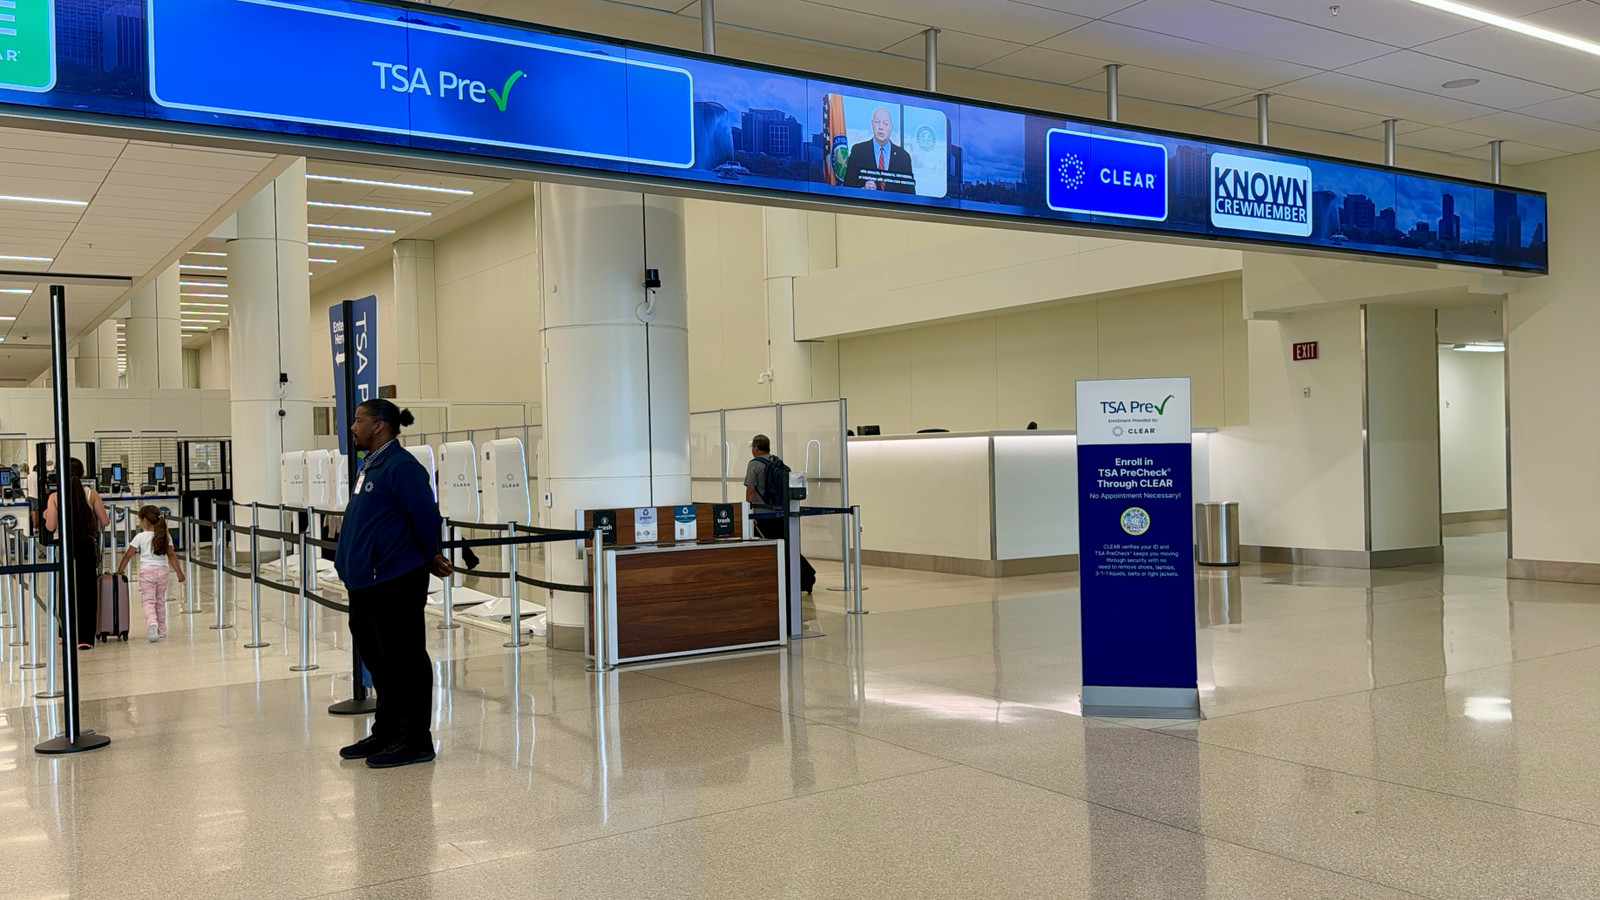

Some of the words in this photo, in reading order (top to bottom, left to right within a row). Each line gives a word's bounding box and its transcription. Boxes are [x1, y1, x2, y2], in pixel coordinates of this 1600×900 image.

[372, 60, 432, 96] TSA
[439, 70, 486, 104] Pre
[1100, 168, 1155, 190] CLEAR
[1214, 166, 1307, 207] KNOWN
[1216, 198, 1307, 222] CREWMEMBER
[332, 320, 344, 333] Ente
[335, 334, 344, 345] Her
[355, 312, 368, 375] TSA
[1296, 344, 1315, 359] EXIT
[1100, 401, 1127, 414] TSA
[1130, 400, 1154, 414] Pre
[1115, 458, 1142, 466] Enroll
[1144, 457, 1153, 466] in
[1098, 469, 1118, 477] TSA
[1097, 480, 1138, 490] Through
[1140, 479, 1173, 488] CLEAR
[1144, 492, 1181, 500] Necessary!
